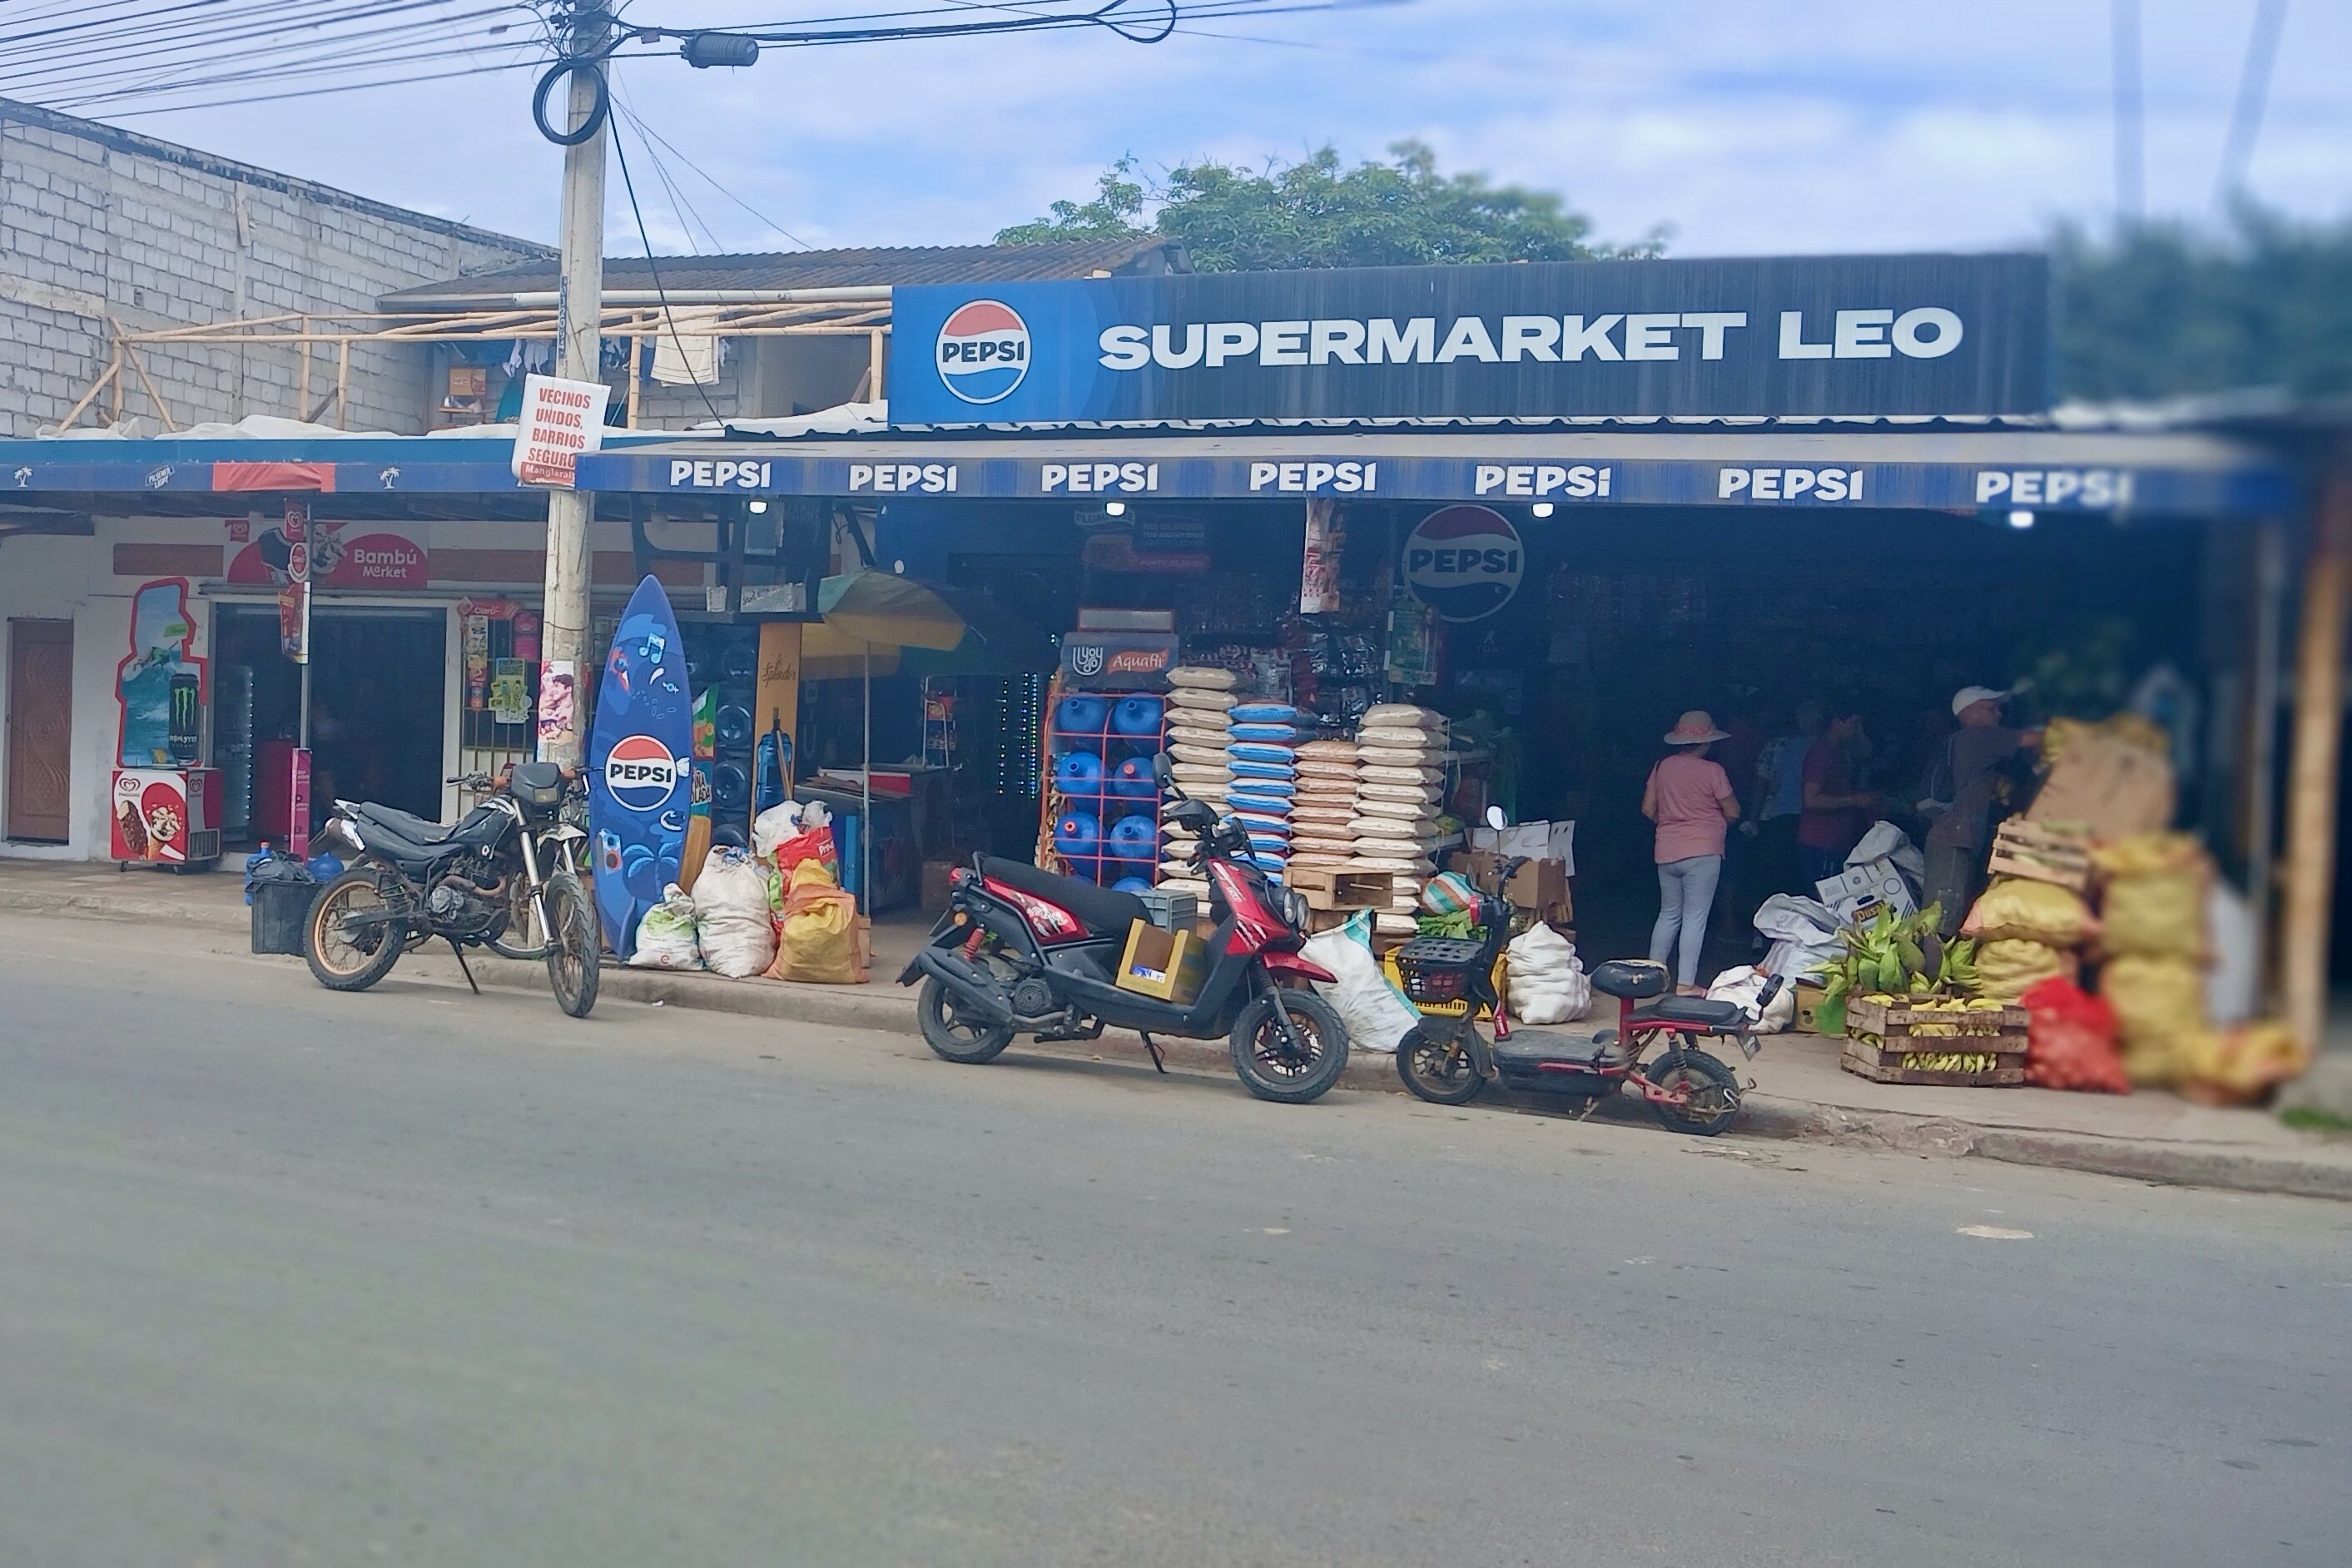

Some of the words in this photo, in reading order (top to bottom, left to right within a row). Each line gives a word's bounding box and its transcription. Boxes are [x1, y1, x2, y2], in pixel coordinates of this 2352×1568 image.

[942, 339, 1025, 363] PEPSI
[1097, 310, 1748, 371] SUPERMARKET
[1778, 306, 1964, 360] LEO
[539, 388, 591, 409] VECINOS
[536, 408, 583, 429] UNIDOS,
[532, 427, 585, 449] BARRIOS
[670, 460, 771, 488] PEPSI
[849, 464, 958, 493] PEPSI
[1041, 463, 1159, 493] PEPSI
[1249, 461, 1377, 493] PEPSI
[1475, 465, 1611, 497] PEPSI
[1718, 468, 1864, 501] PEPSI
[1976, 470, 2133, 506] PEPSI
[354, 548, 417, 565] Bambú
[1409, 548, 1518, 573] PEPSI
[363, 565, 407, 578] Market
[610, 763, 672, 783] PEPSI
